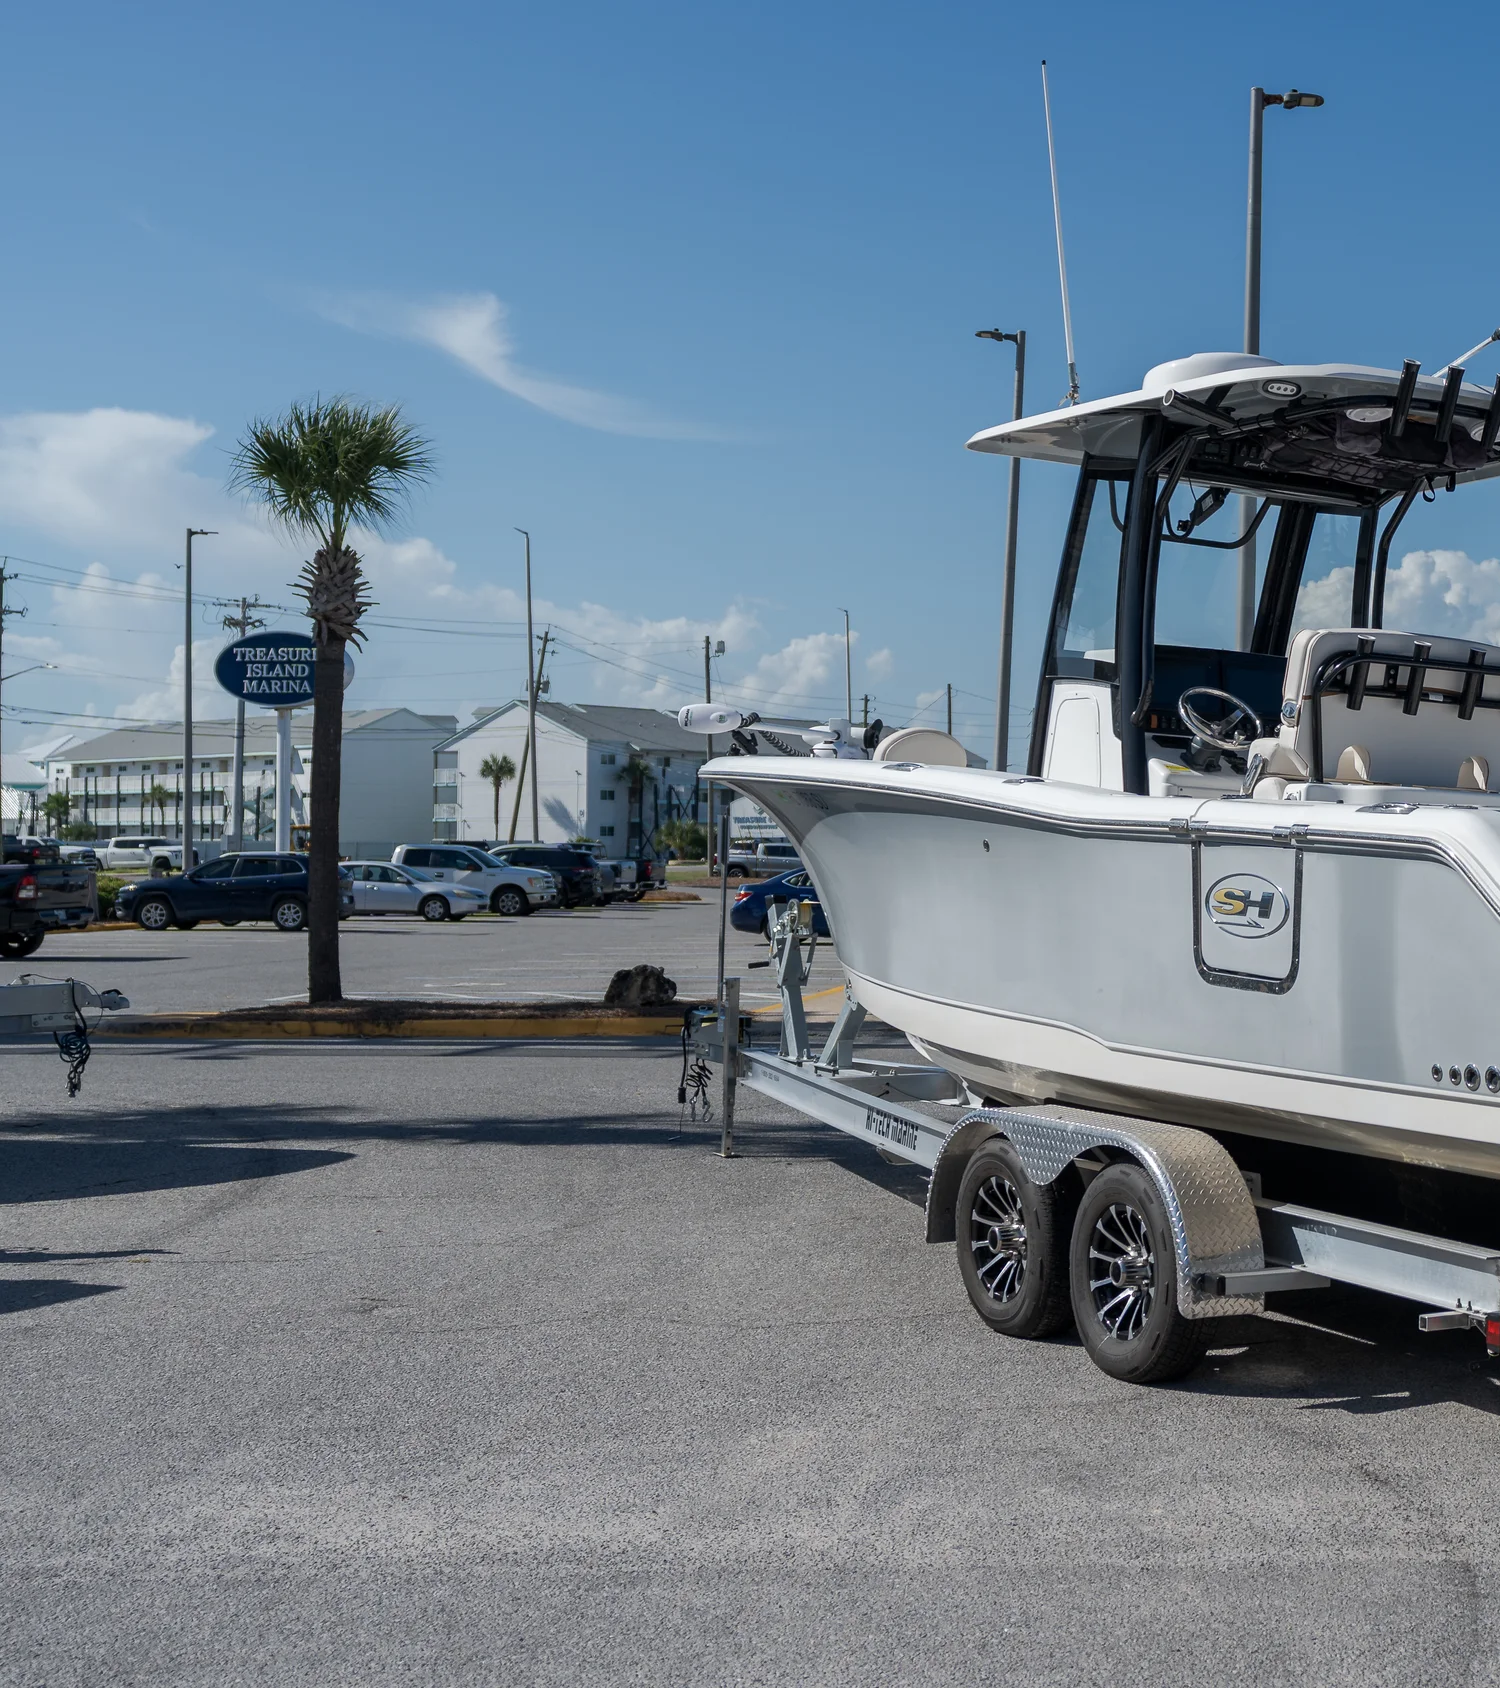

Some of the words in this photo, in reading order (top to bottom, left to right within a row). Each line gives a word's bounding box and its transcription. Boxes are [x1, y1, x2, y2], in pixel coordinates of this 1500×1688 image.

[246, 663, 309, 678] ISLAND
[242, 679, 312, 694] MARINA
[1211, 887, 1275, 919] SH
[865, 1105, 891, 1139] HI-TECH
